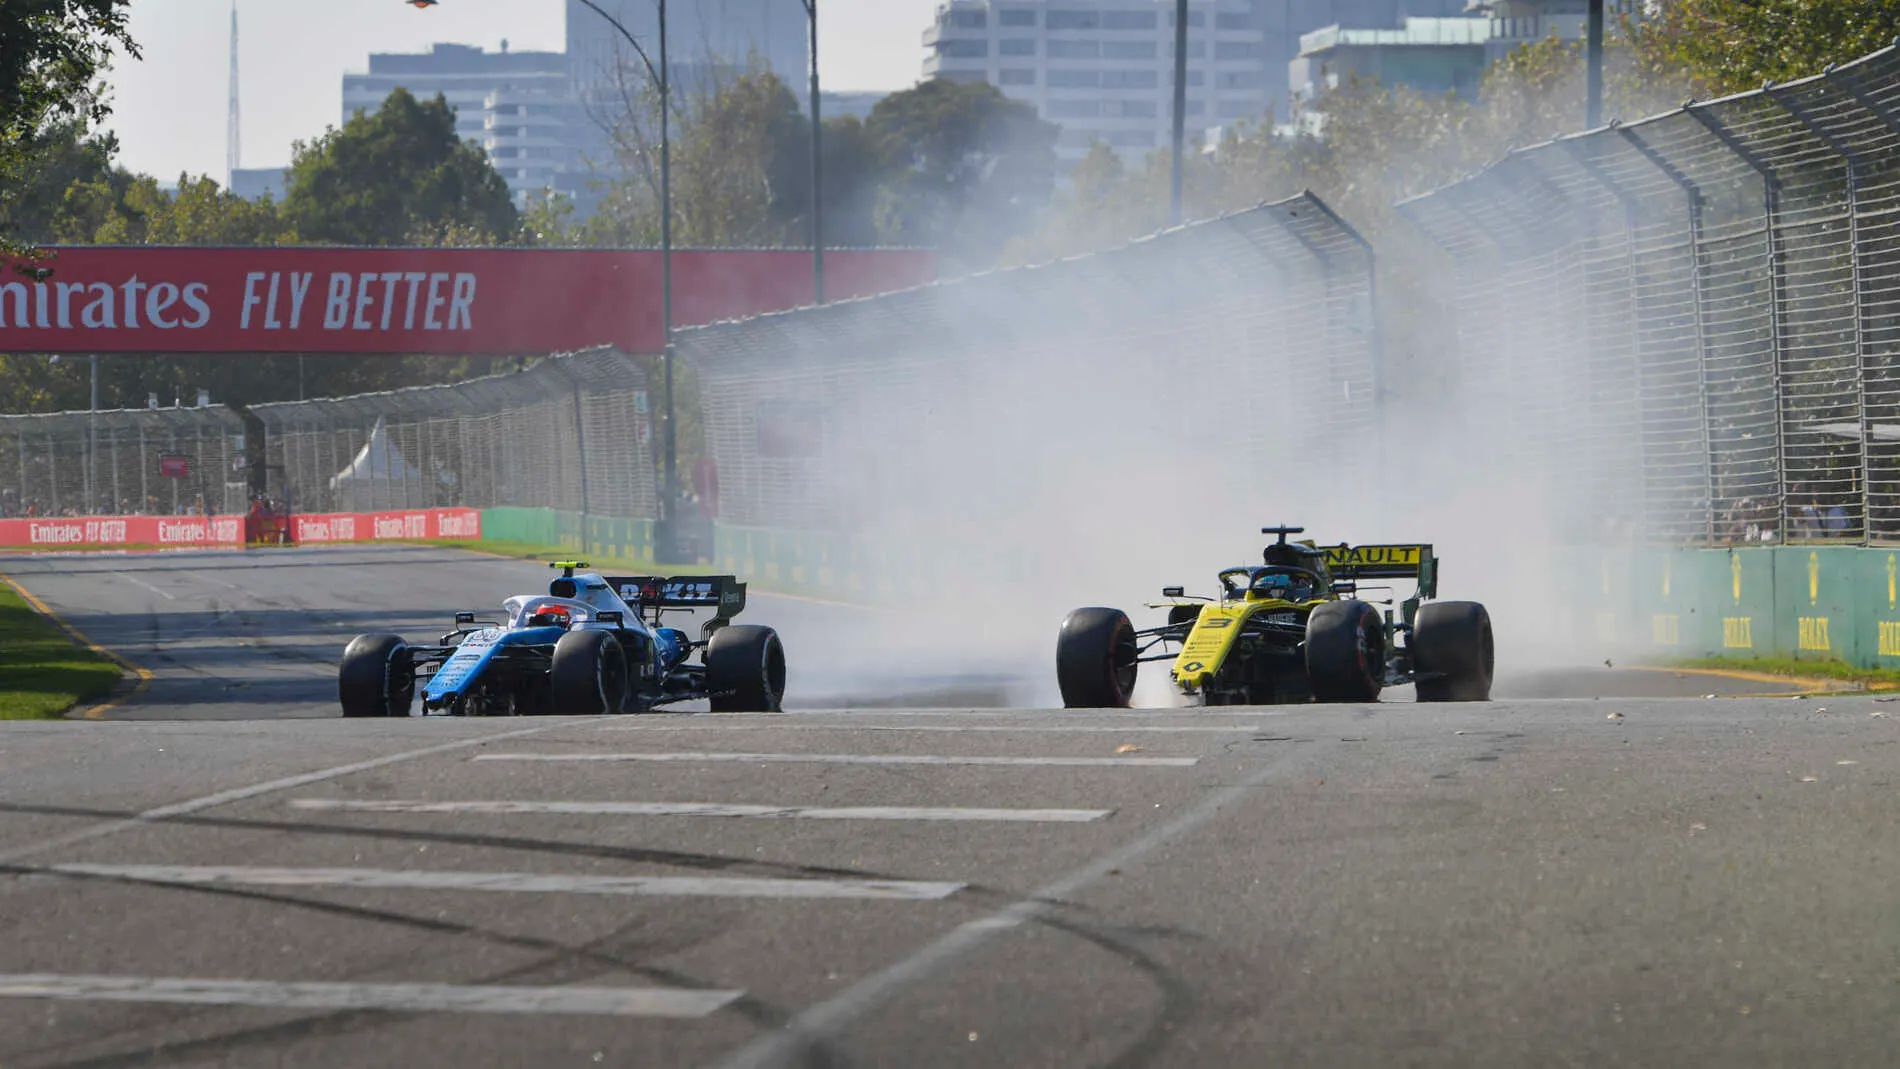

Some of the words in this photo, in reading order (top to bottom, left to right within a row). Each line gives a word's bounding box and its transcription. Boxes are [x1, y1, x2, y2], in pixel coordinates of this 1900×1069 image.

[240, 271, 313, 329] FLY
[323, 271, 476, 330] BETTER
[30, 523, 82, 543] Emirates
[159, 520, 204, 543] Emirates
[1798, 616, 1830, 650] ROLEX
